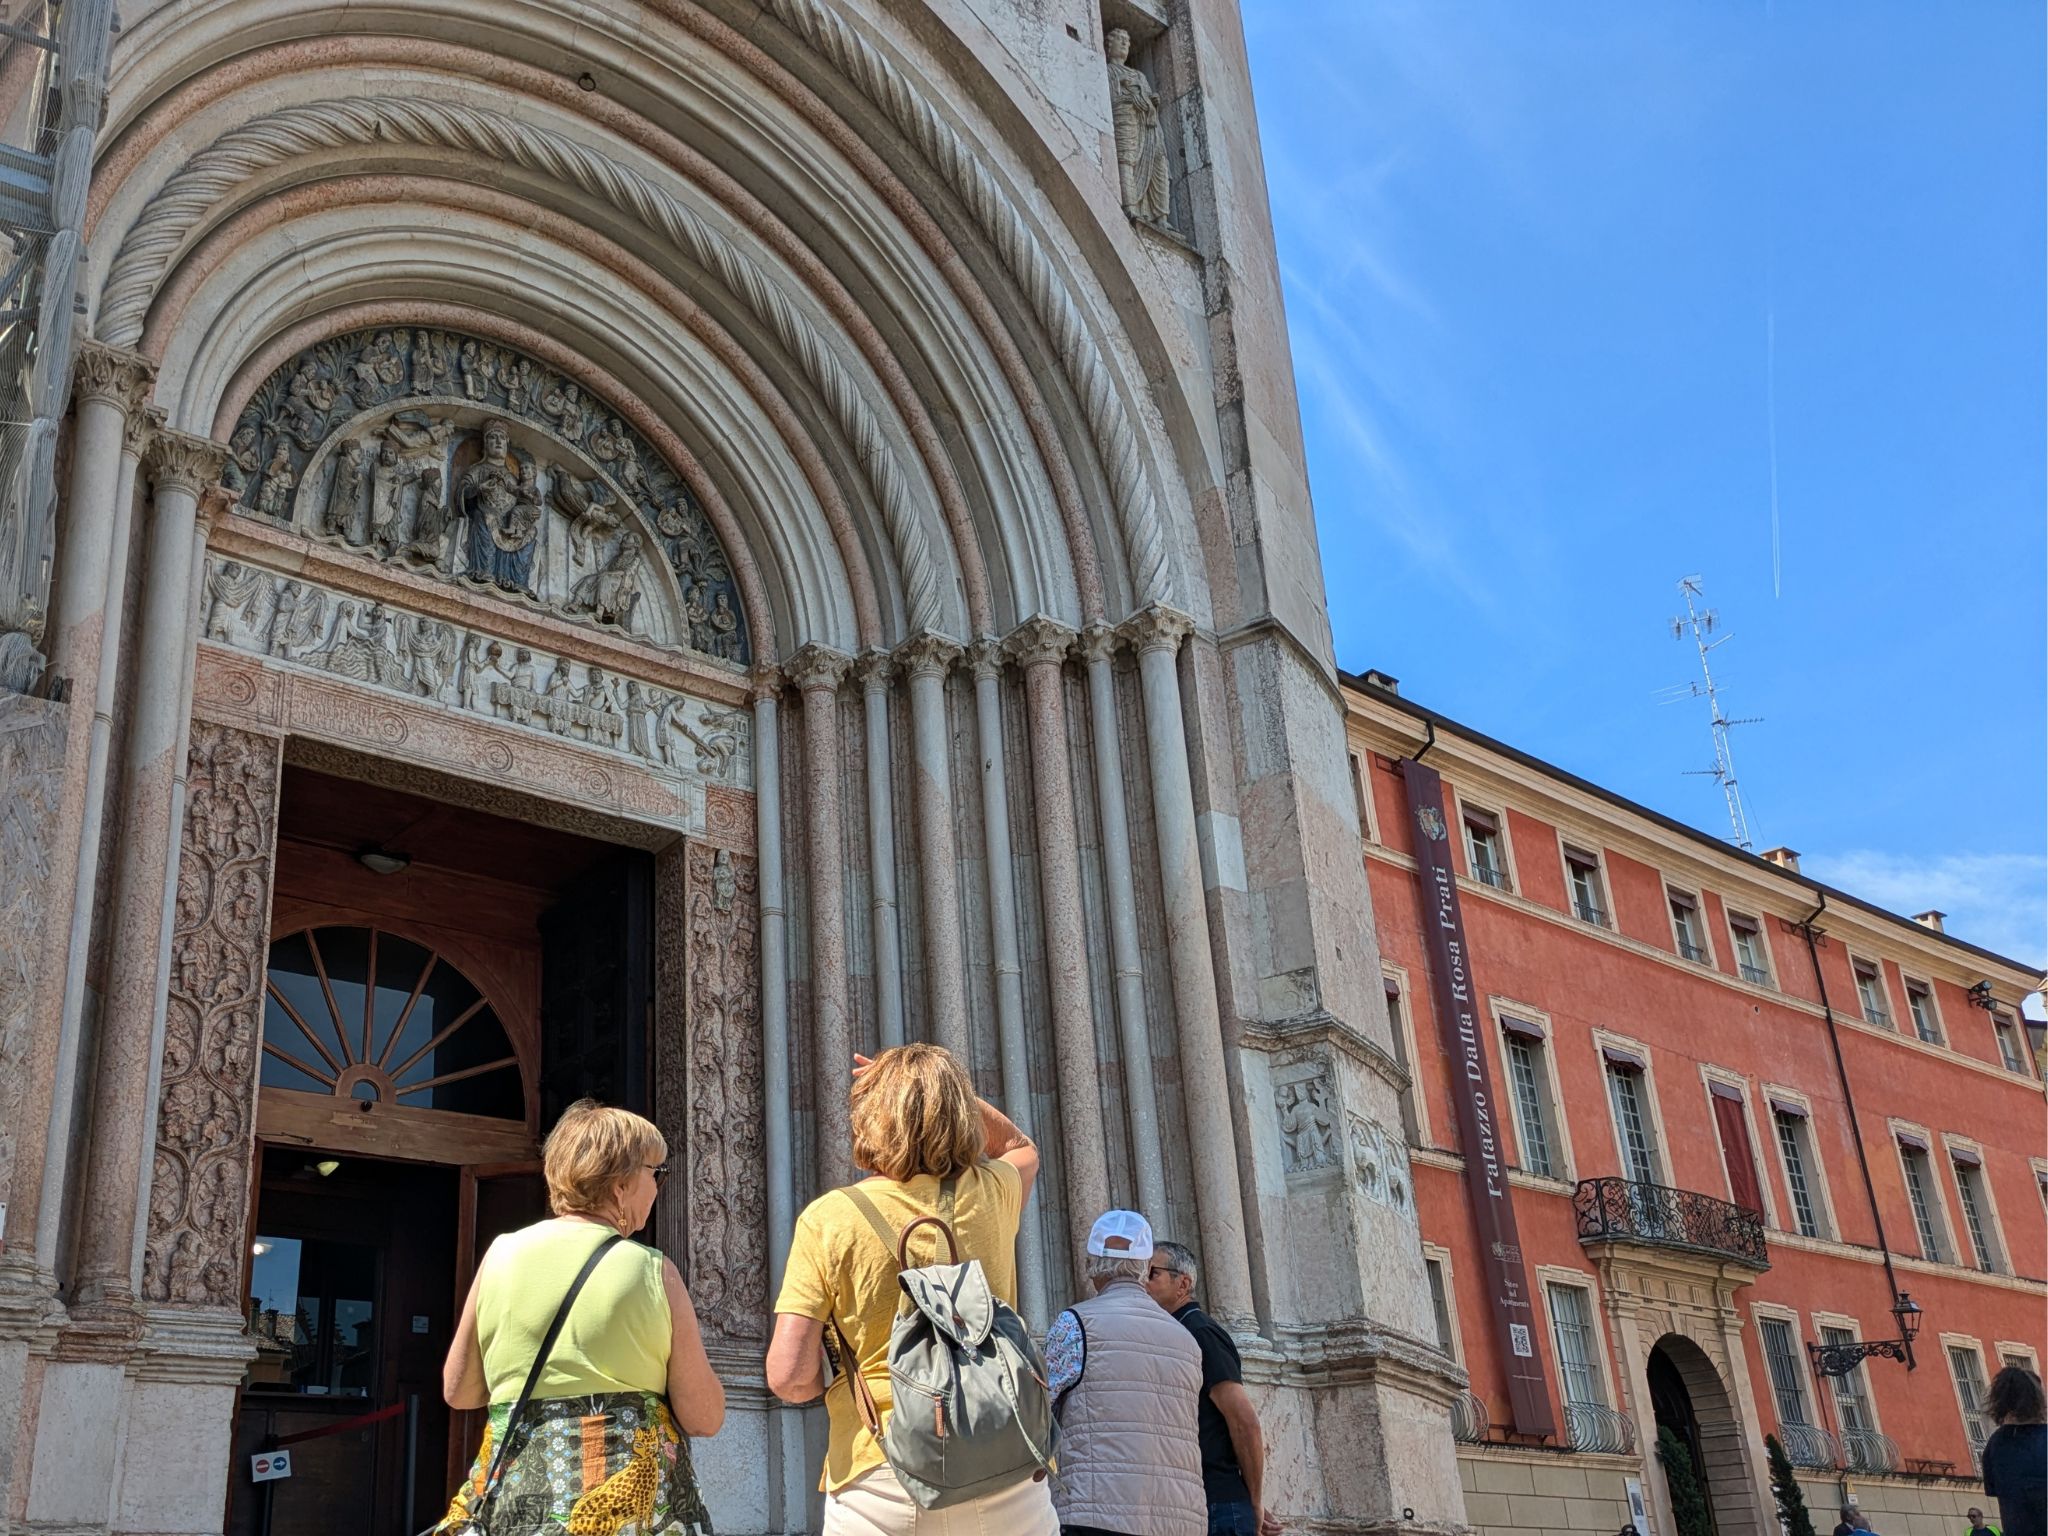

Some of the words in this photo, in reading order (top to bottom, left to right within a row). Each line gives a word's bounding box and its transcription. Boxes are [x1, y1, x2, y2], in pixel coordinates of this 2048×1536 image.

[1432, 866, 1456, 932] Prati
[1448, 940, 1469, 1004] Rosa
[1459, 1013, 1483, 1084] Dalla
[1474, 1092, 1503, 1200] Palazzo
